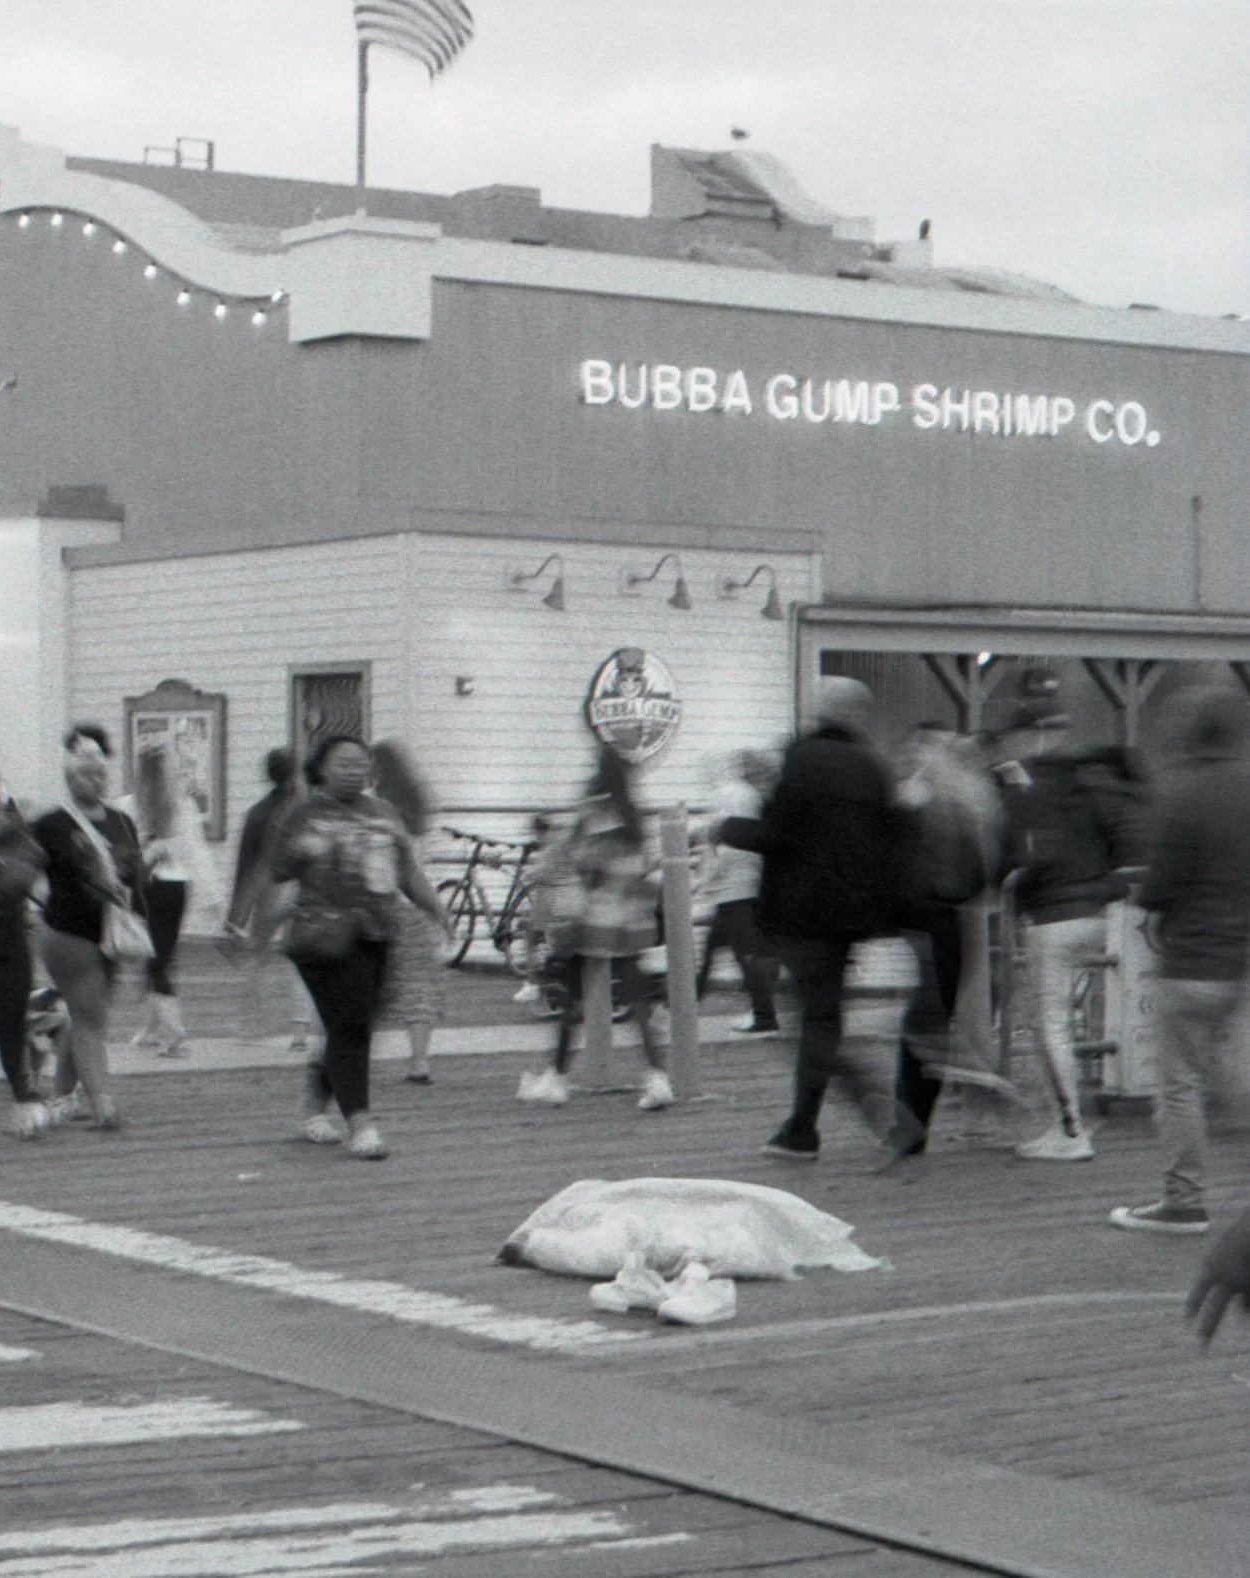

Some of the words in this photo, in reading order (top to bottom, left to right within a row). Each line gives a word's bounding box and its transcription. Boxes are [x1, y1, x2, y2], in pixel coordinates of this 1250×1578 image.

[581, 359, 752, 415] BUBBA
[765, 373, 900, 425] GUMP
[912, 383, 1075, 437] SHRIMP
[1085, 399, 1161, 447] CO.
